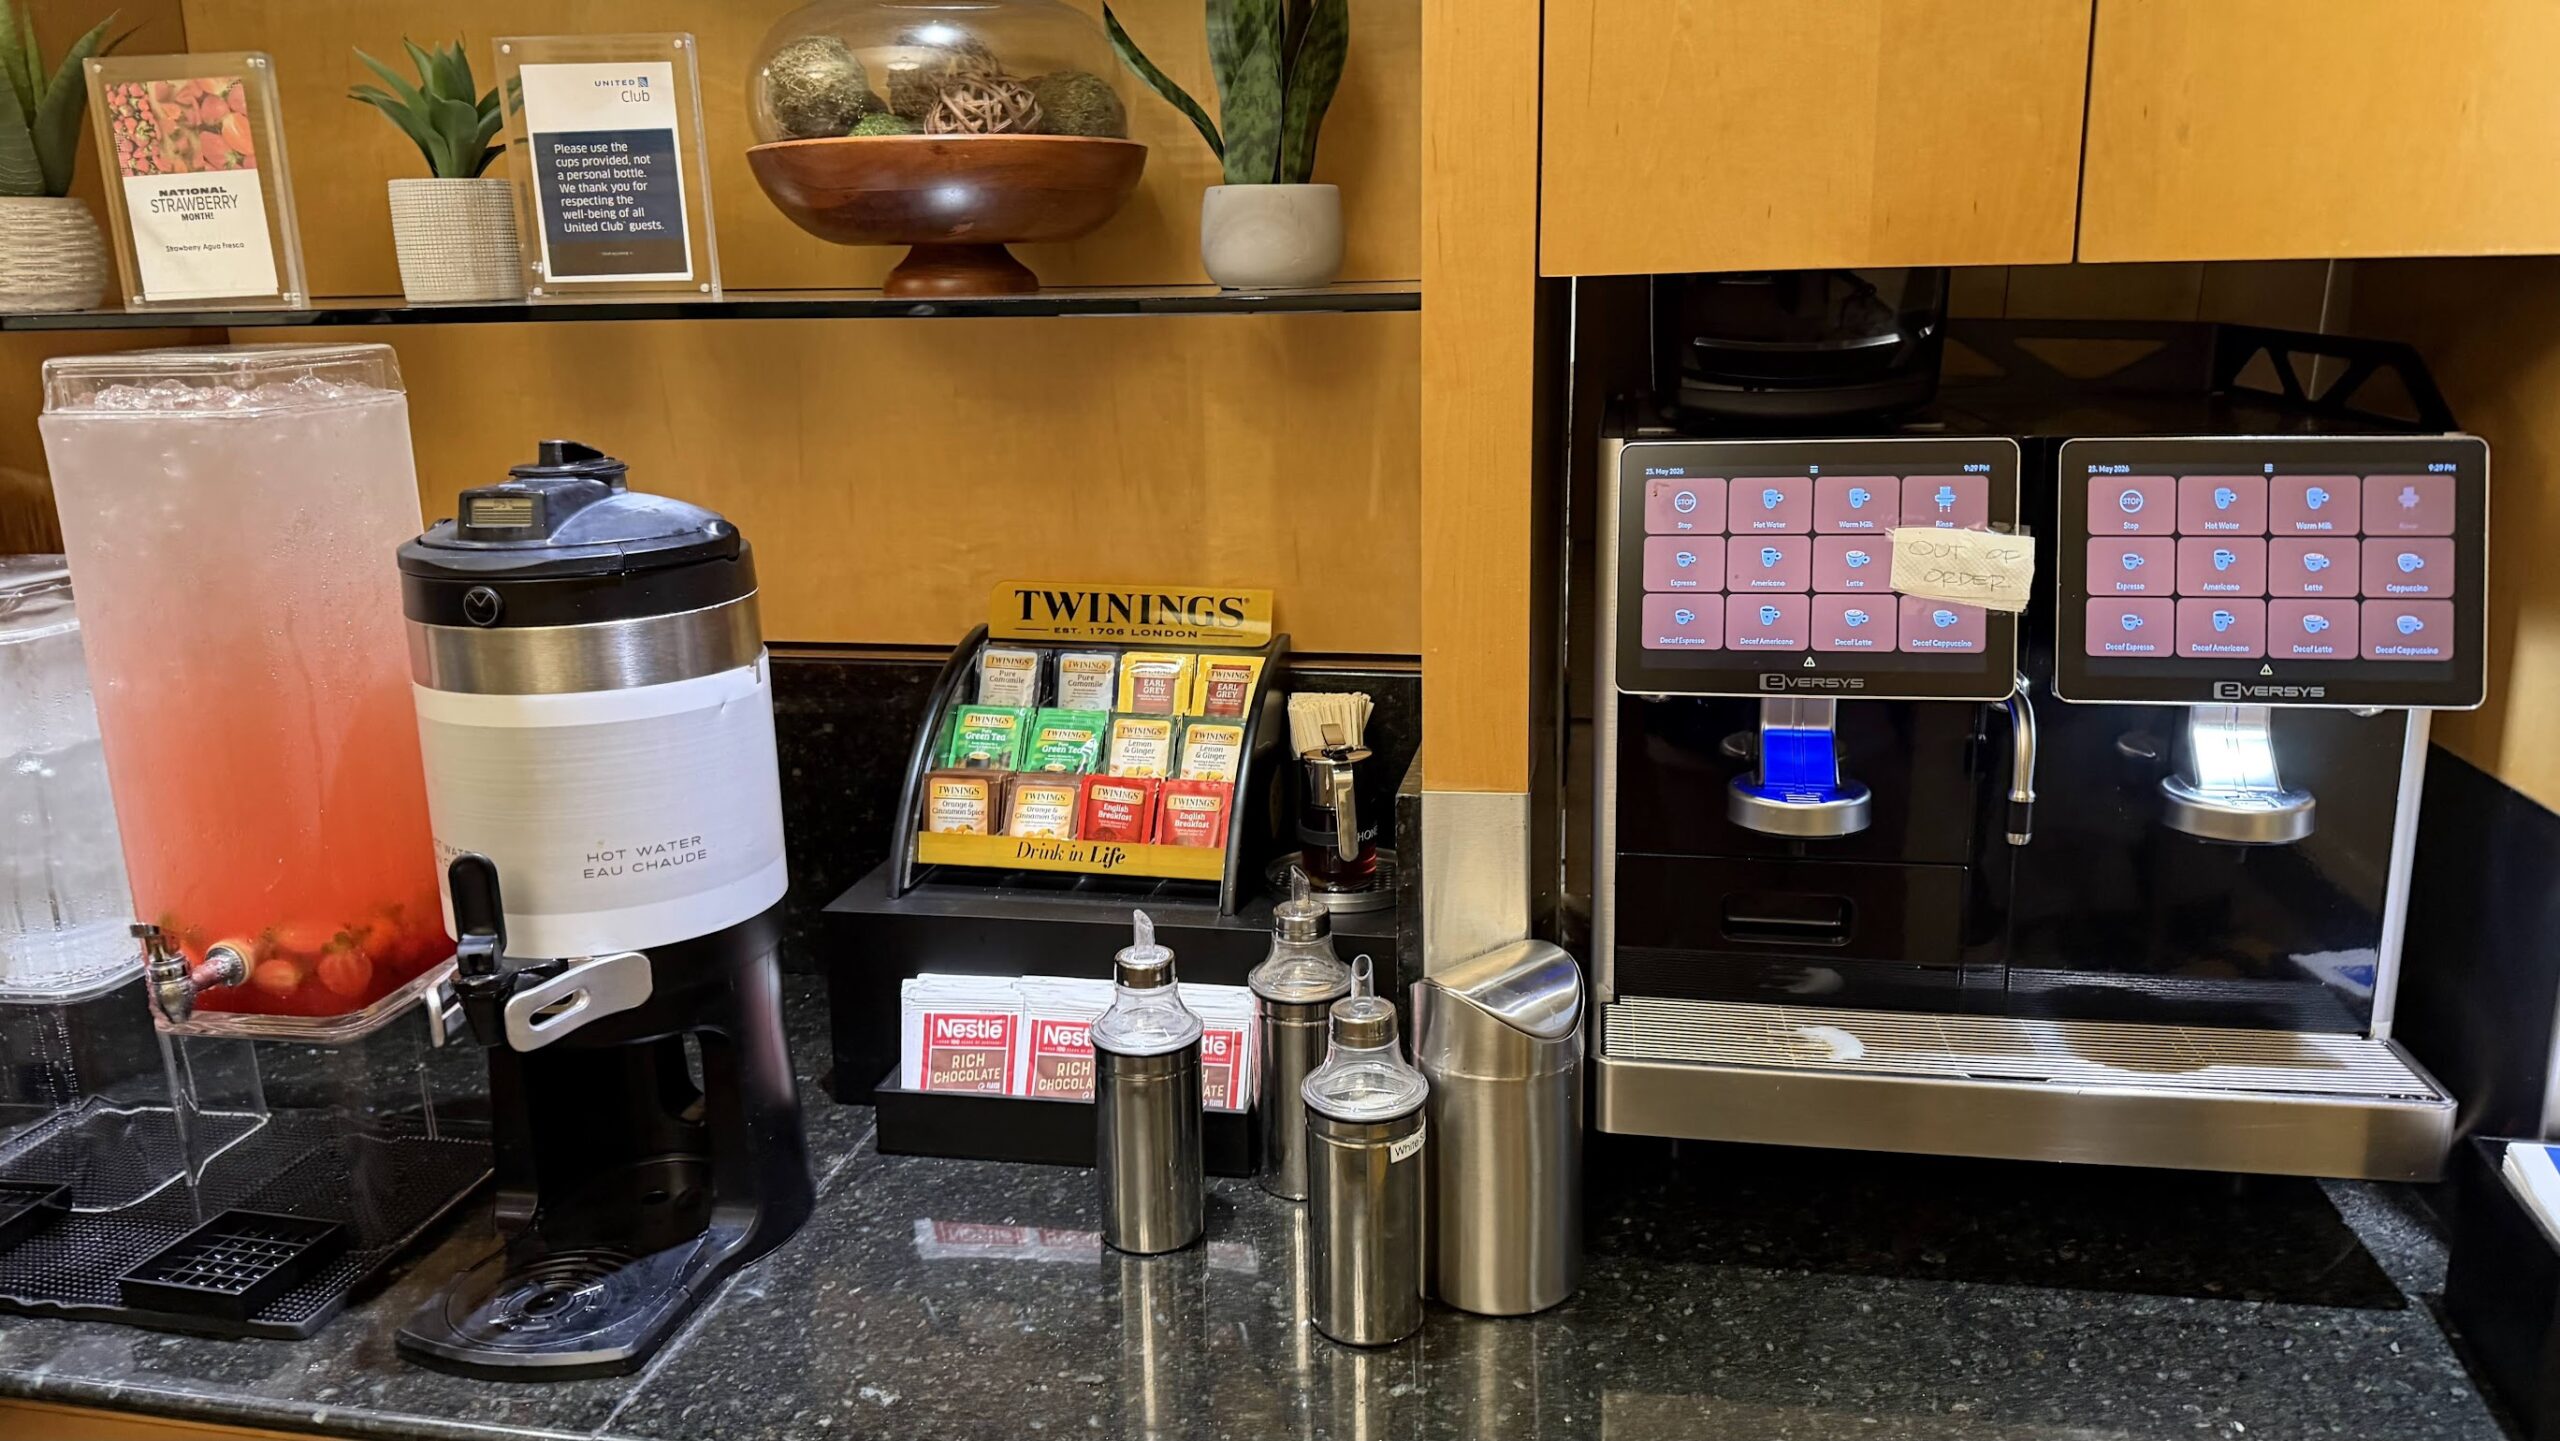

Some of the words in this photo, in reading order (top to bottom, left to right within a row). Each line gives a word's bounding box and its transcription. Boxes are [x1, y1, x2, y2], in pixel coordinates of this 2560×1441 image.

[594, 79, 635, 87] UNITED
[621, 90, 650, 103] Club
[553, 143, 588, 154] Please
[590, 144, 608, 153] use
[610, 142, 628, 152] the
[555, 158, 580, 168] cups
[582, 155, 632, 168] provided,
[633, 155, 651, 165] not
[557, 172, 564, 181] a
[566, 169, 611, 182] personal
[613, 168, 647, 179] bottle.
[158, 186, 227, 197] NATIONAL
[559, 184, 576, 194] We
[578, 182, 608, 193] thank
[610, 182, 630, 194] you
[632, 181, 648, 191] for
[150, 194, 238, 213] STRAWBERRY
[560, 195, 614, 208] respecting
[616, 195, 634, 205] the
[181, 212, 214, 221] MONTH!
[562, 208, 617, 220] well-being
[618, 207, 630, 218] of
[632, 207, 645, 217] all
[564, 222, 598, 233] United
[629, 220, 665, 232] guests.
[203, 243, 221, 251] Agua
[2122, 497, 2141, 506] STOP
[1677, 521, 1693, 530] Stop
[1753, 521, 1765, 529] Hot
[1766, 521, 1786, 529] Water
[1838, 520, 1859, 529] Warm
[1859, 520, 1874, 528] Milk
[2123, 521, 2139, 530] Stop
[2204, 521, 2217, 530] Hot
[2218, 521, 2240, 530] Water
[2296, 521, 2317, 530] Warm
[2318, 521, 2332, 530] Milk
[1908, 540, 1966, 560] OUT
[1670, 579, 1697, 588] Espresso
[1751, 579, 1786, 587] Americano
[1846, 579, 1864, 587] Latte
[2116, 582, 2145, 591] Espresso
[2203, 582, 2240, 591] Americano
[2304, 583, 2323, 592] Latte
[2386, 583, 2429, 593] Cappuccino
[1014, 590, 1245, 629] TWININGS
[1054, 627, 1082, 635] EST.
[1090, 627, 1124, 636] 1706
[1131, 629, 1198, 639] LONDON
[1659, 636, 1678, 645] Decaf
[1679, 636, 1705, 646] Espresso
[1740, 637, 1758, 645] Decaf
[1759, 637, 1794, 646] Americano
[1835, 638, 1854, 646] Decaf
[1854, 638, 1872, 646] Latte
[1912, 639, 1932, 647] Decaf
[1932, 639, 1973, 649] Cappuccino
[2105, 642, 2125, 651] Decaf
[2126, 642, 2155, 652] Espresso
[2192, 643, 2212, 651] Decaf
[2213, 643, 2250, 652] Americano
[2293, 645, 2314, 653] Decaf
[2314, 645, 2333, 654] Latte
[2375, 645, 2396, 654] Decaf
[2397, 645, 2439, 656] Cappuccino
[990, 656, 1030, 666] TWININGS
[1067, 660, 1107, 669] TWININGS
[999, 669, 1017, 677] Pure
[1077, 673, 1095, 681] Pure
[1211, 670, 1250, 680] TWININGS
[989, 675, 1024, 685] Camomile
[1067, 679, 1103, 688] Camomile
[1143, 679, 1166, 688] EARL
[1143, 686, 1166, 695] GREY
[1217, 683, 1239, 692] EARL
[1216, 690, 1238, 699] GREY
[969, 714, 1011, 726] TWININGS
[1045, 729, 1088, 739] TWININGS
[1121, 726, 1163, 736] TWININGS
[1193, 731, 1235, 741] TWININGS
[965, 732, 990, 741] Green
[991, 732, 1006, 742] Tea
[1042, 745, 1067, 754] Green
[1131, 747, 1156, 756] Ginger
[1199, 745, 1224, 753] Lemon
[1202, 752, 1227, 761] Ginger
[938, 785, 980, 796] TWININGS
[1096, 787, 1140, 800] TWININGS
[1023, 792, 1067, 802] TWININGS
[1172, 797, 1216, 807] TWININGS
[942, 800, 967, 809] Orange
[968, 801, 974, 809] &
[1103, 802, 1129, 814] English
[931, 807, 967, 815] Cinnamon
[967, 808, 985, 817] Spice
[1026, 806, 1051, 814] Orange
[1014, 812, 1050, 820] Cinnamon
[1050, 813, 1068, 822] Spice
[1098, 810, 1132, 822] Breakfast
[1179, 811, 1206, 821] English
[1174, 819, 1209, 829] Breakfast
[586, 849, 627, 862] HOT
[636, 835, 702, 857] WATER
[1016, 841, 1064, 861] Drink
[1069, 844, 1083, 862] in
[1090, 845, 1126, 869] Life
[583, 865, 623, 879] EAU
[632, 849, 707, 873] CHAUDE
[937, 1018, 1004, 1040] Nestlé
[1043, 1025, 1091, 1047] Nest
[951, 1053, 985, 1069] RICH
[1056, 1061, 1091, 1077] RICH
[933, 1067, 1001, 1084] CHOCOLATE
[1038, 1077, 1093, 1091] CHOCOLA
[1394, 1140, 1419, 1156] White
